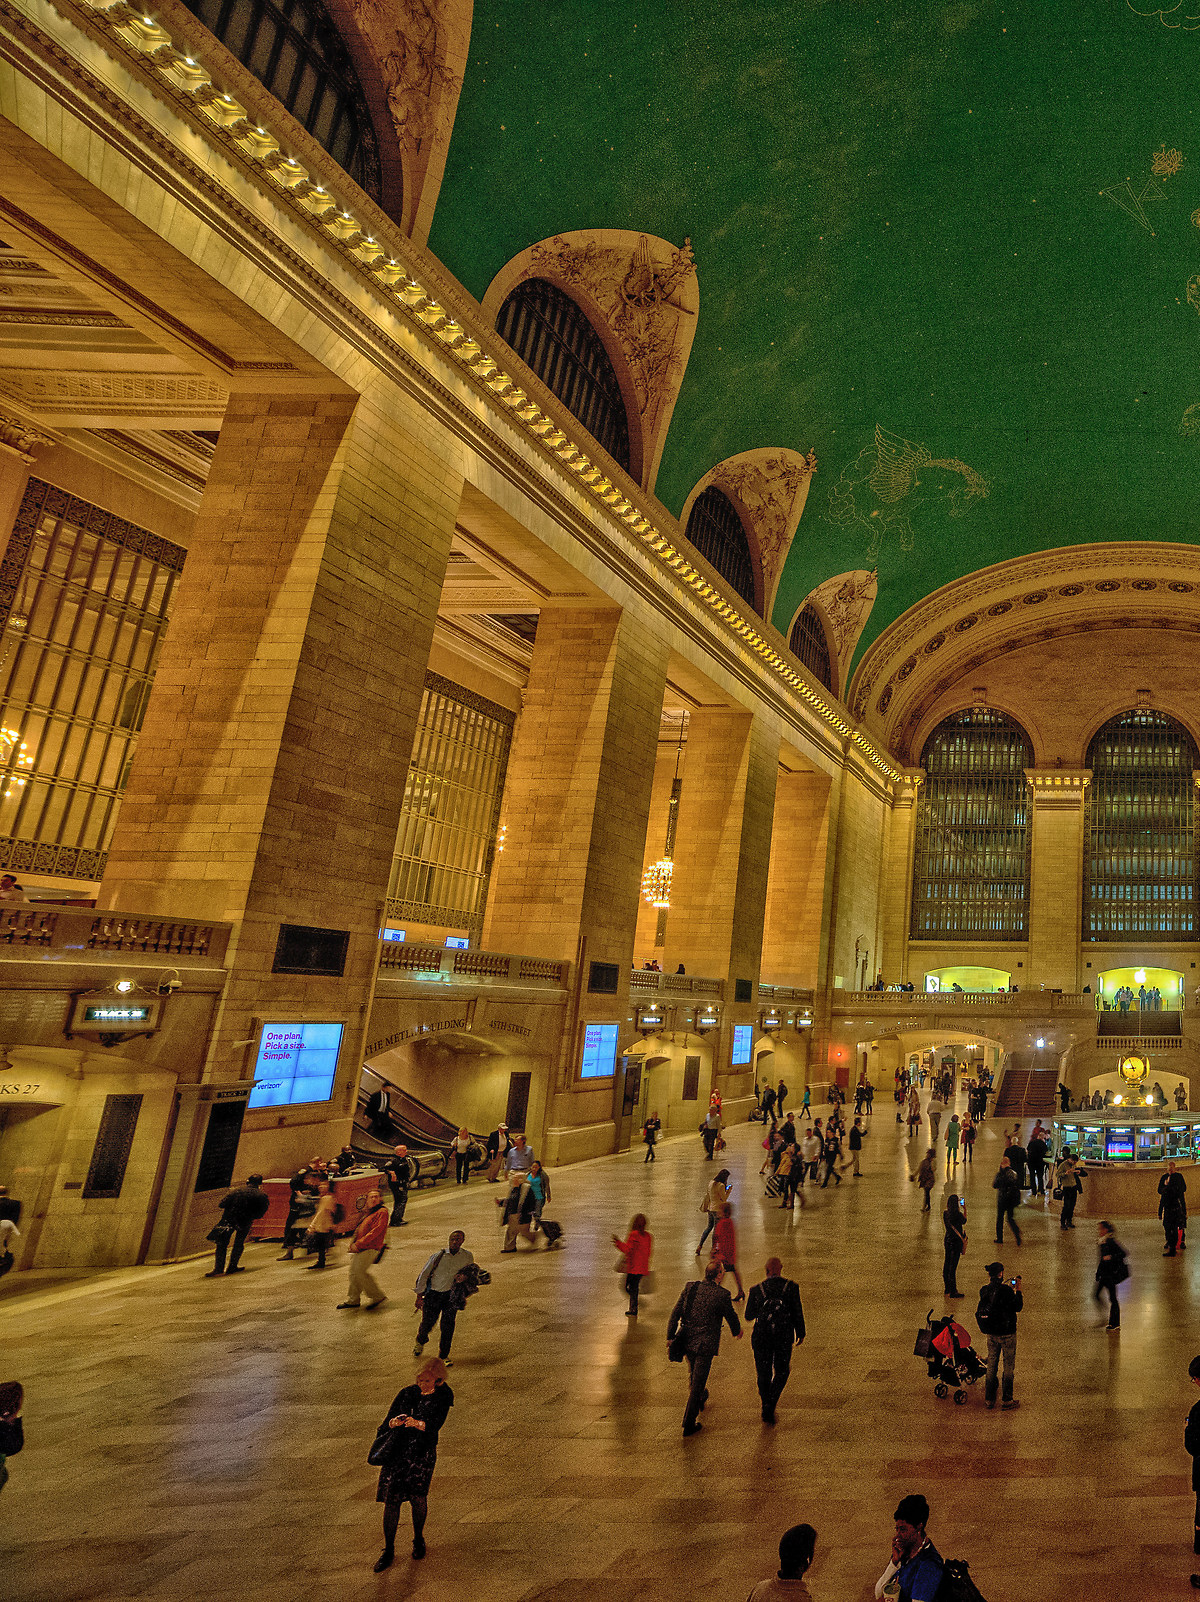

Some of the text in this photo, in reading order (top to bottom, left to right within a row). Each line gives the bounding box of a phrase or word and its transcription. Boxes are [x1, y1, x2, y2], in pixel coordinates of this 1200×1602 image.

[489, 1020, 532, 1037] 45TH STREET
[267, 1032, 302, 1041] One plan.
[265, 1041, 283, 1050] Pick
[289, 1041, 307, 1050] size.
[365, 1040, 384, 1057] THE
[263, 1051, 292, 1061] Simple.
[22, 1084, 40, 1095] 27
